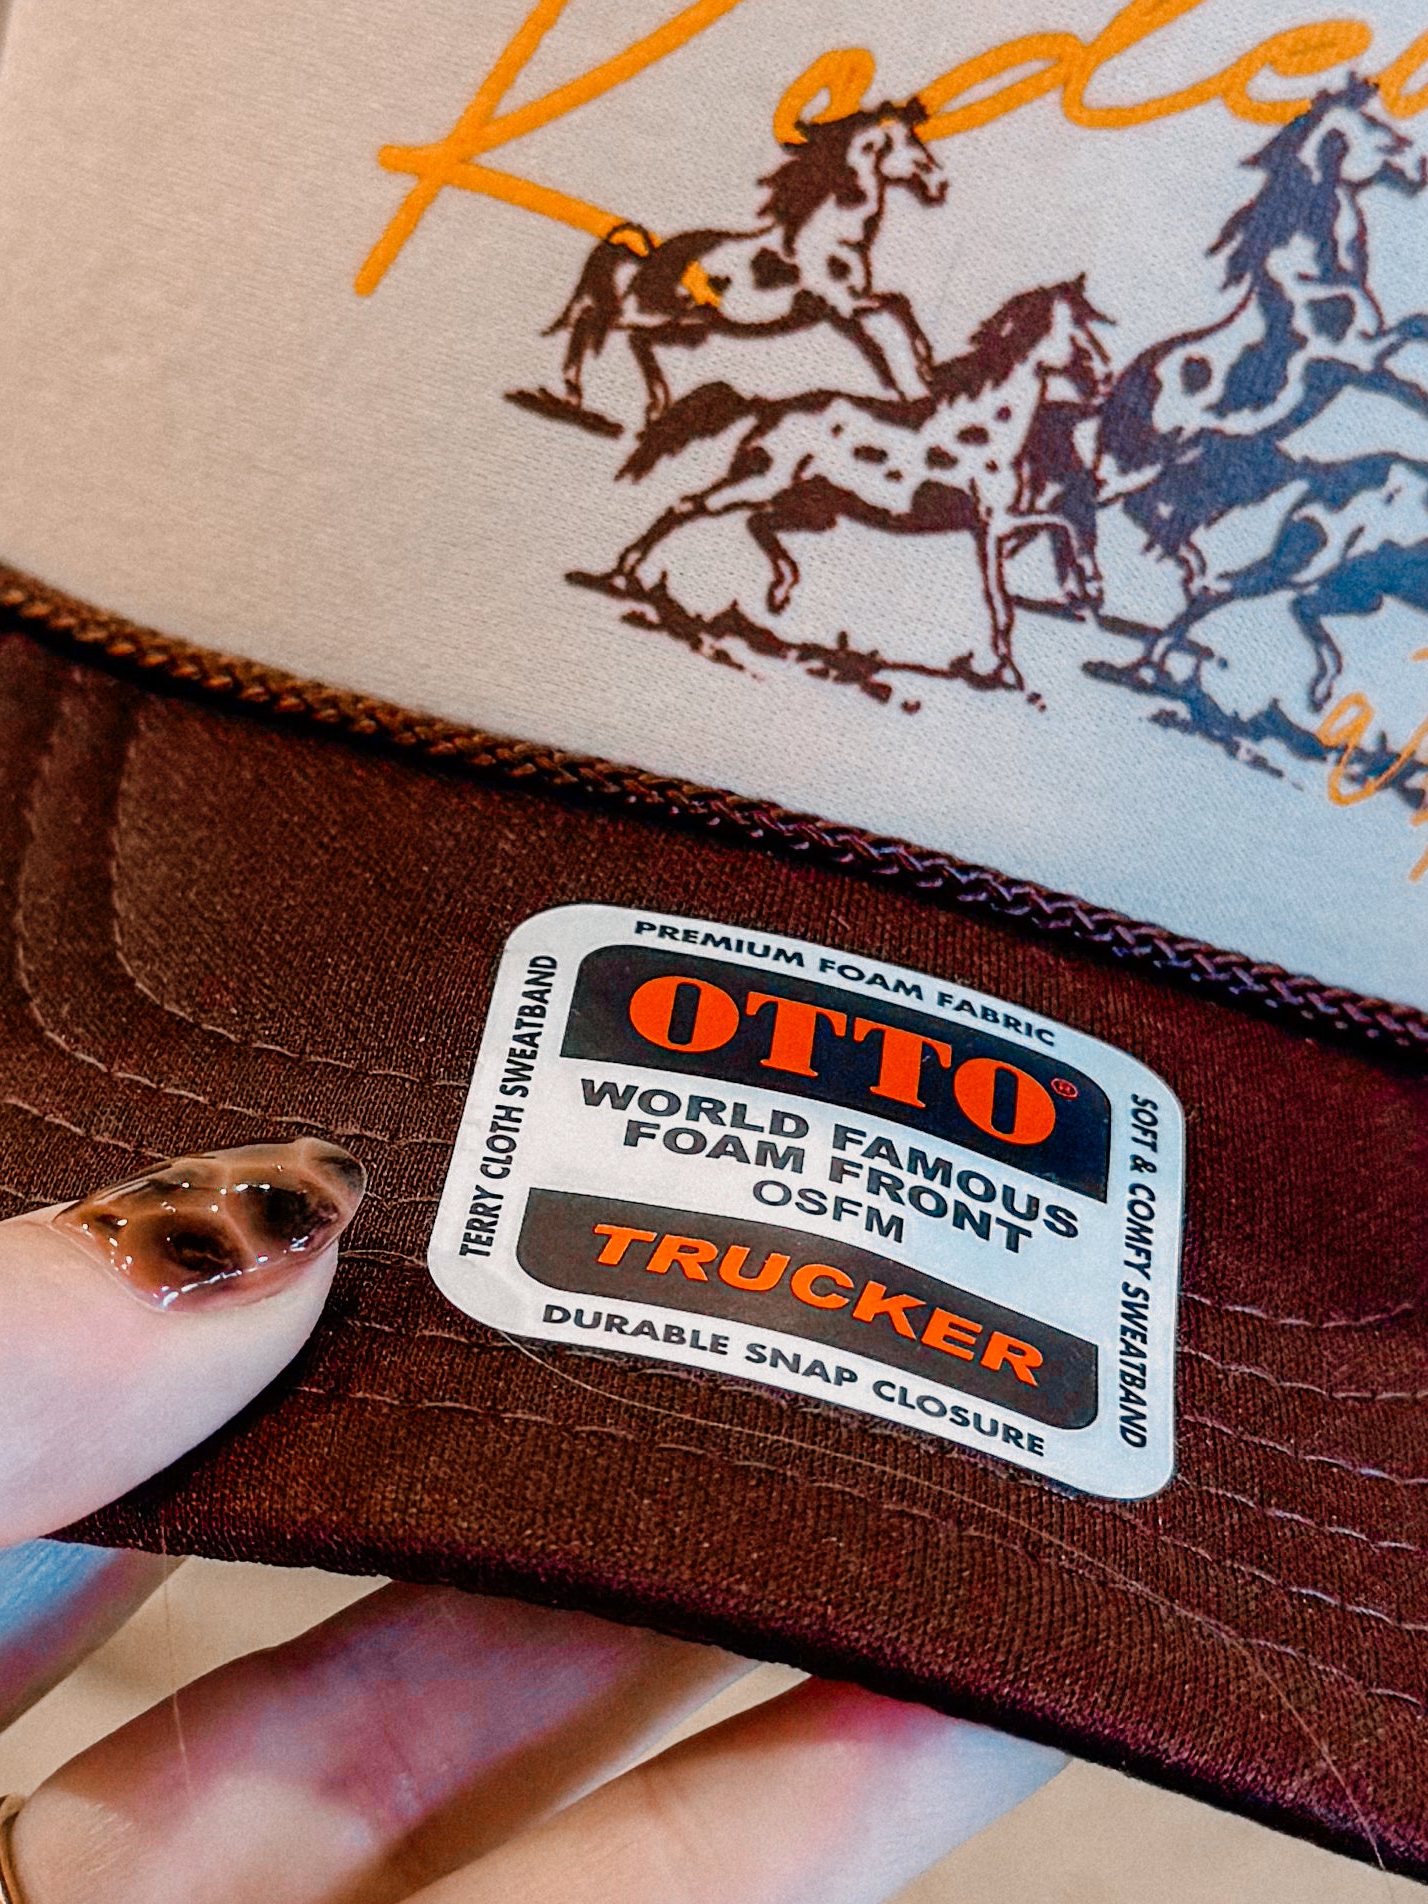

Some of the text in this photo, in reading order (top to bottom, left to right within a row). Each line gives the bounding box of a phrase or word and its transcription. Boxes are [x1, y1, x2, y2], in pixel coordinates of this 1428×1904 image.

[628, 975, 1057, 1148] OTTO
[634, 920, 1057, 1047] PREMIUM FOAM FABRIC
[459, 954, 558, 1257] TERRY CLOTH SWEATBAND
[580, 1077, 1080, 1239] WORLD FAMOUS
[622, 1118, 1033, 1254] FOAM FRONT
[751, 1178, 906, 1245] OSFM
[1118, 1092, 1159, 1450] SOFT & COMFY SWEATBAND
[541, 1303, 1047, 1458] DURABLE SNAP CLOSURE
[592, 1222, 1045, 1389] TRUCKER
